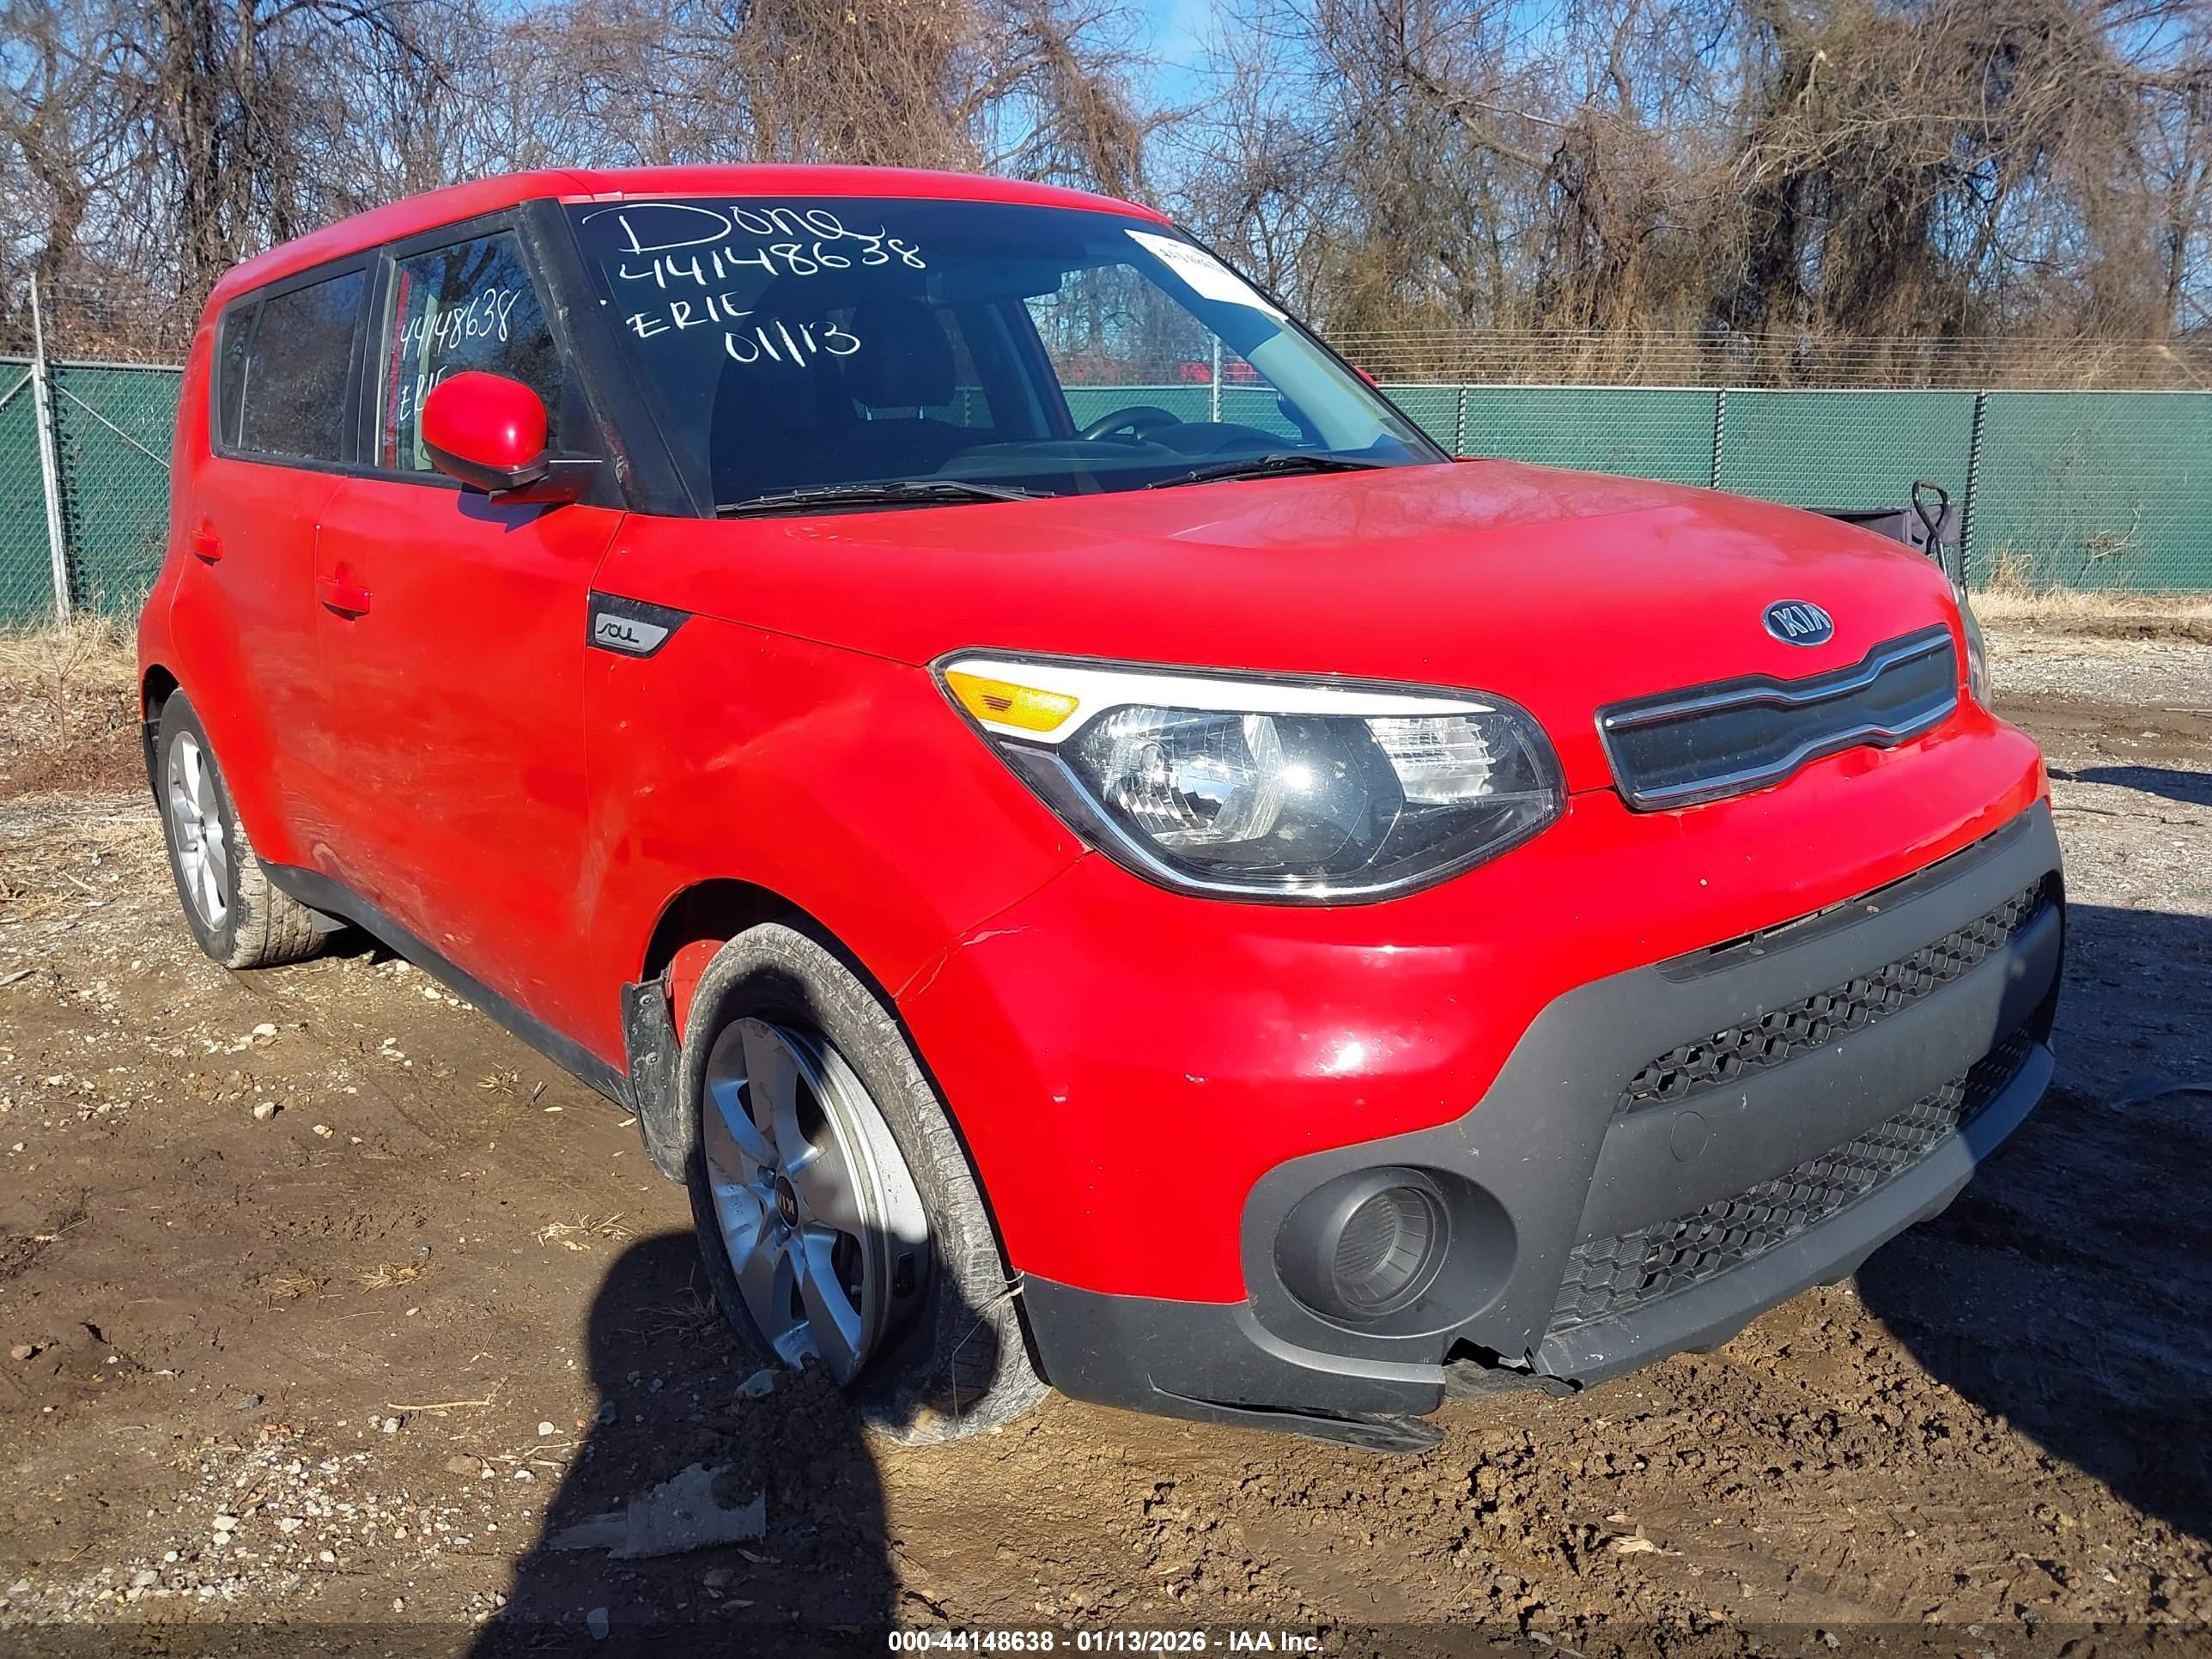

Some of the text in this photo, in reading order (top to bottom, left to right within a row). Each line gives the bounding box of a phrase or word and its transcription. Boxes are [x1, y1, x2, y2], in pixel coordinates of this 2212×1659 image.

[582, 204, 885, 254] Done
[619, 234, 927, 289] 44148638
[399, 288, 522, 361] 44148638
[625, 291, 755, 338] ERIE
[725, 320, 860, 368] 01/13
[1771, 604, 1831, 637] KIA
